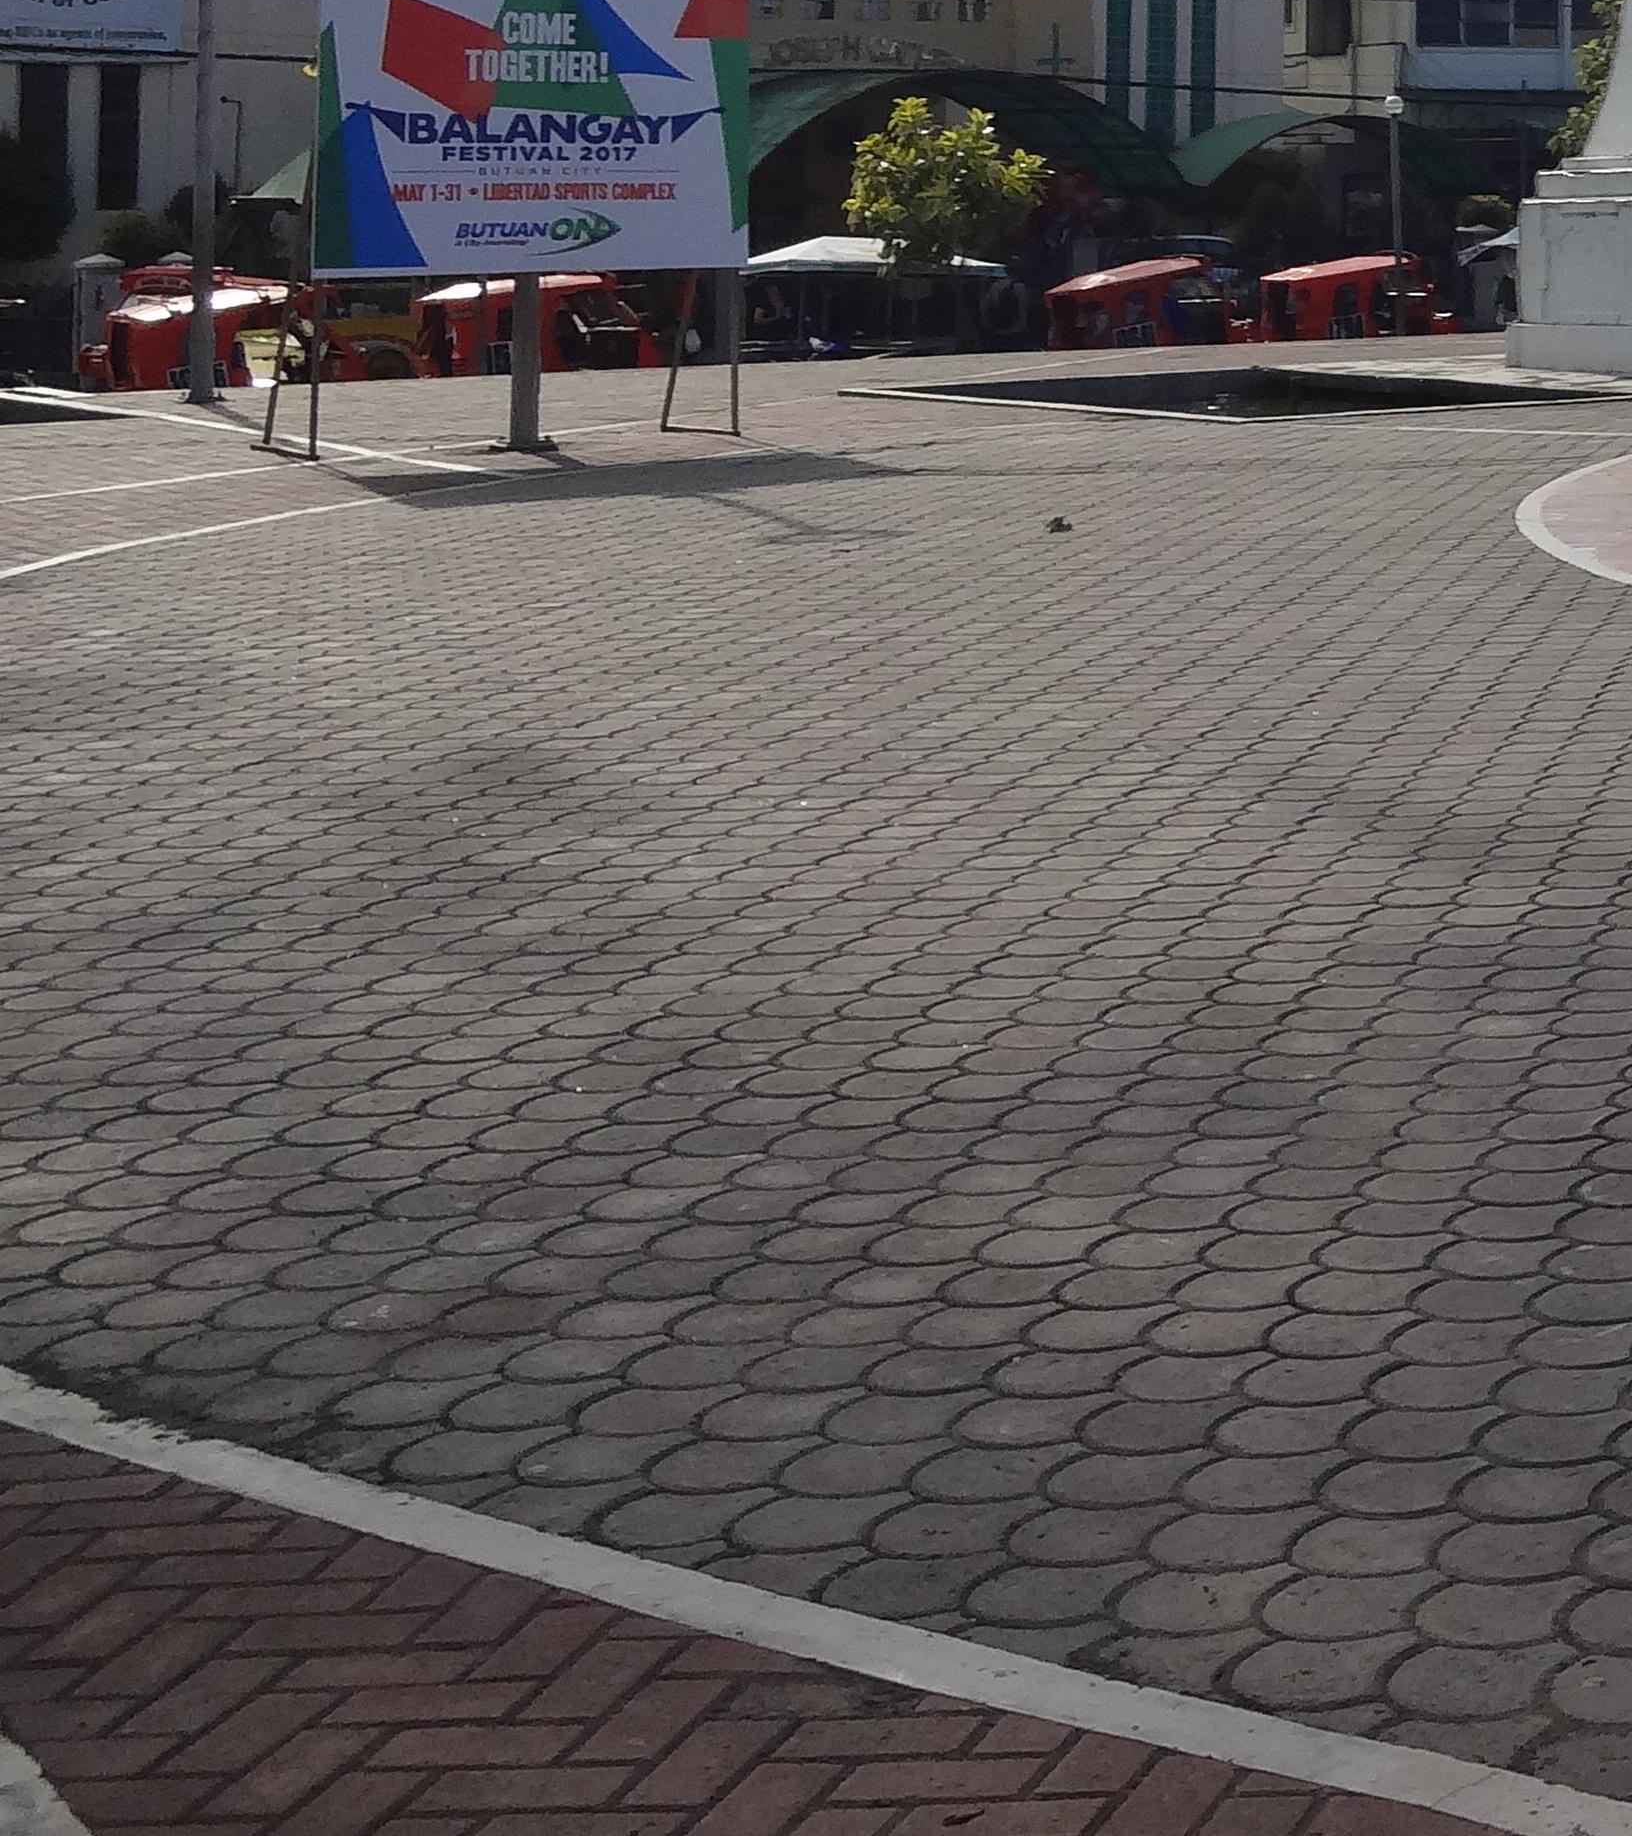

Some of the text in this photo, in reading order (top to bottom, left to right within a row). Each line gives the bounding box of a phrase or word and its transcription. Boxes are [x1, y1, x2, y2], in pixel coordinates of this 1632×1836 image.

[503, 12, 577, 45] COME
[464, 49, 609, 83] TOGETHER!
[407, 112, 672, 145] BALANGAY
[441, 146, 638, 162] FESTIVAL 2017
[393, 183, 676, 202] MAY 1-31 LIBERTAD SPORTS COMPLEX
